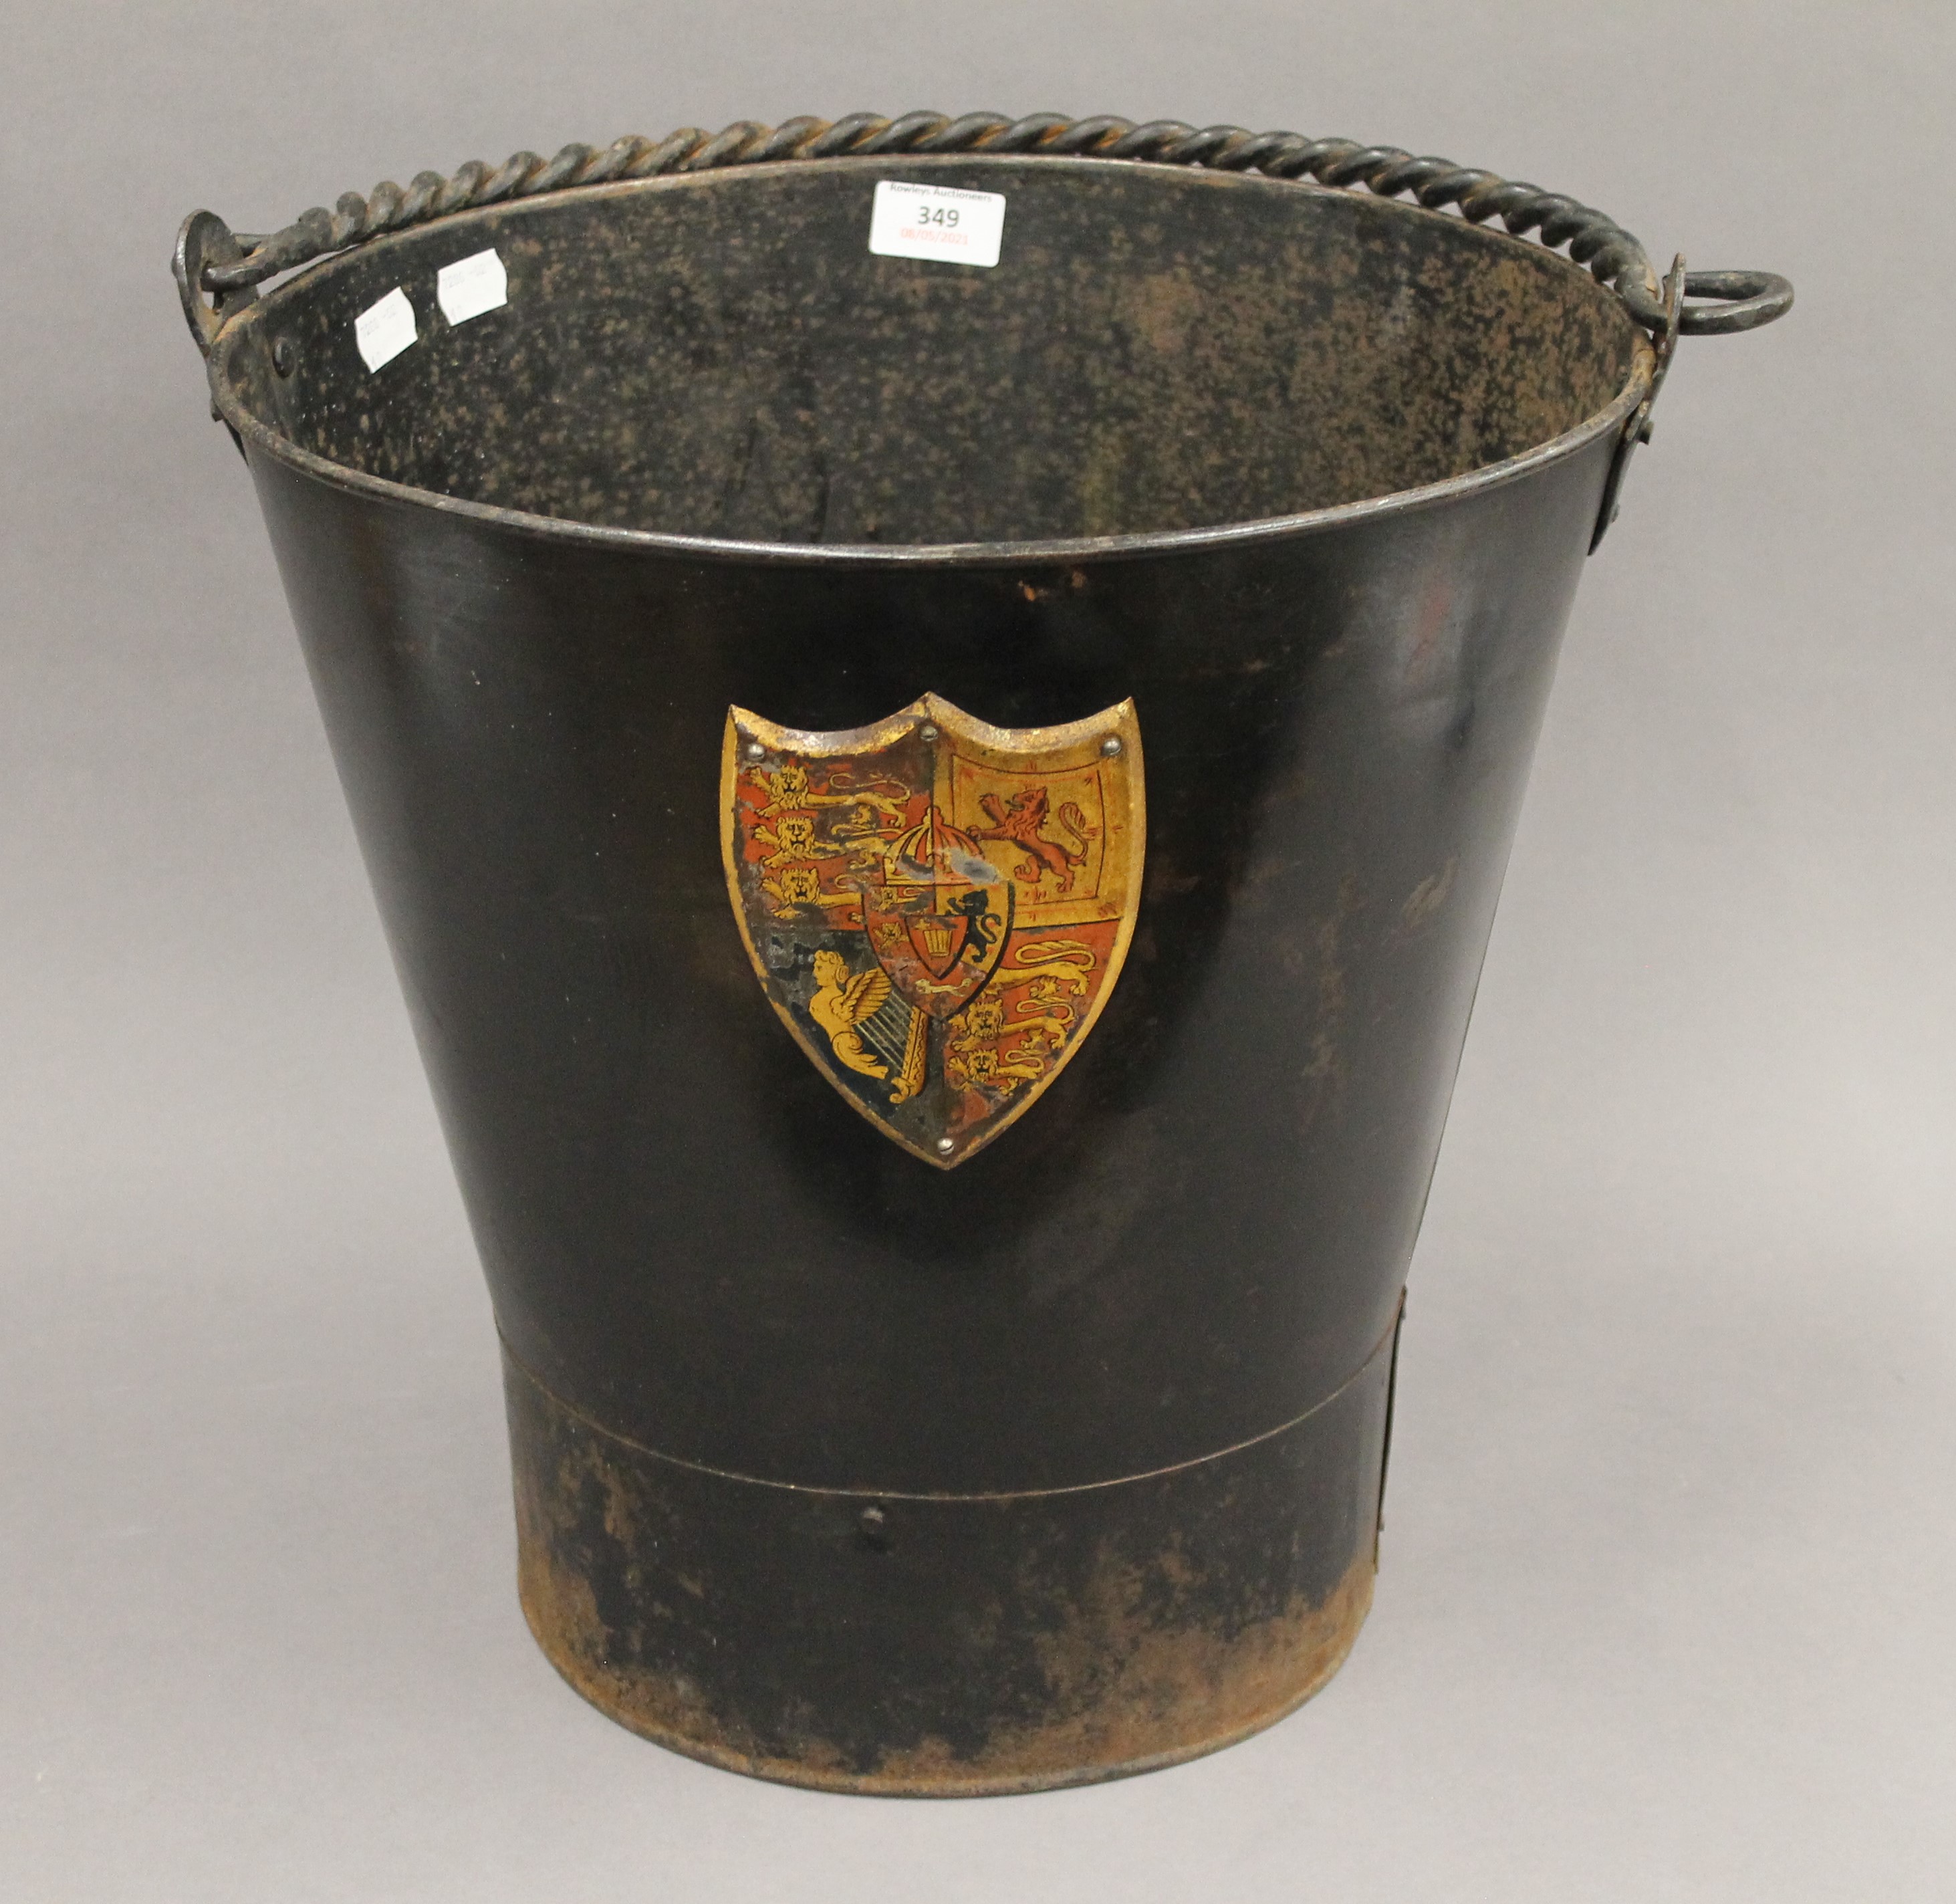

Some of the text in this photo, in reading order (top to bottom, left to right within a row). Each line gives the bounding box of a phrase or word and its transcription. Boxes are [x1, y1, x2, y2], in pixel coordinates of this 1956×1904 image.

[890, 183, 992, 202] Rowleys Auctioneers
[918, 206, 959, 227] 349
